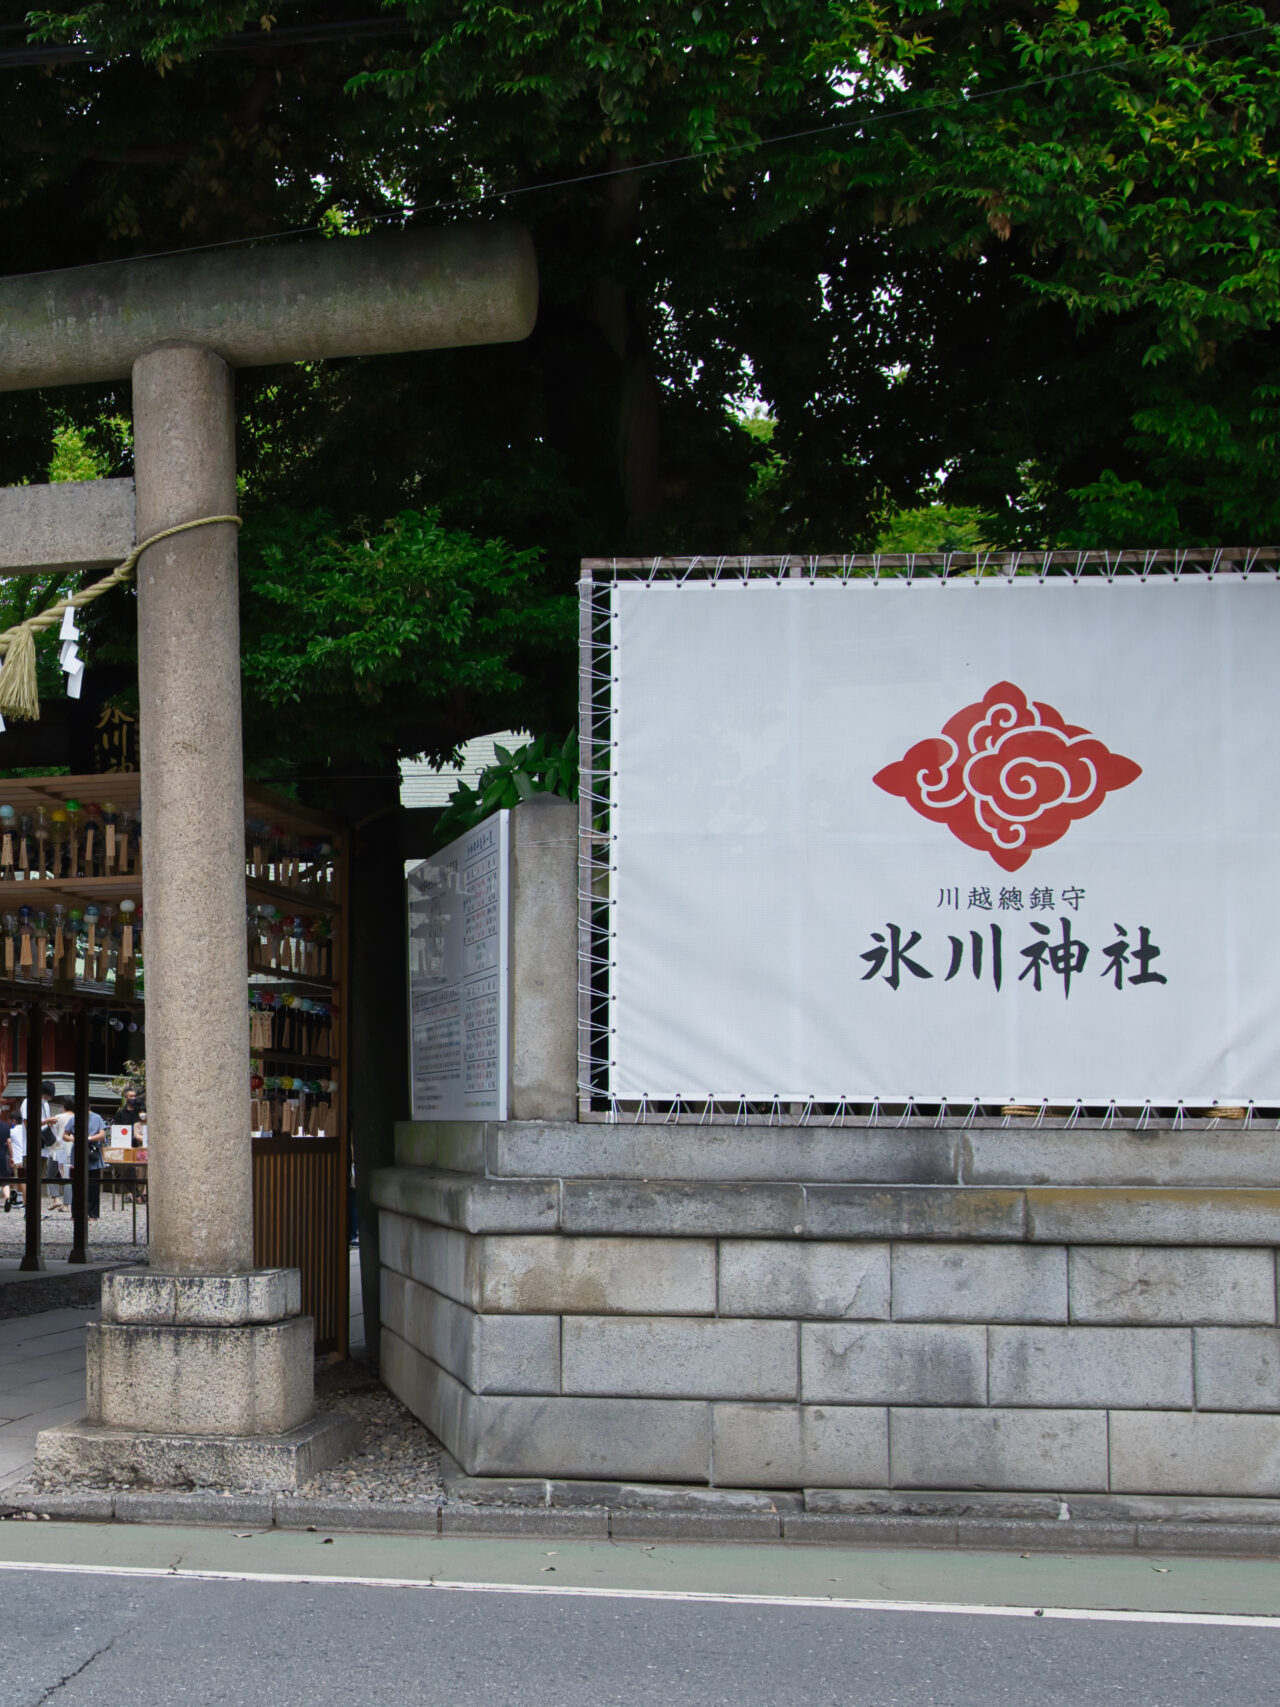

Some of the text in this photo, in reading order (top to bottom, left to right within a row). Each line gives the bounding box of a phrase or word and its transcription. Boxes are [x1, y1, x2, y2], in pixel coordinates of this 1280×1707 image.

[937, 886, 1086, 911] 川越總鎮守
[859, 916, 1168, 1000] 氷川神社
